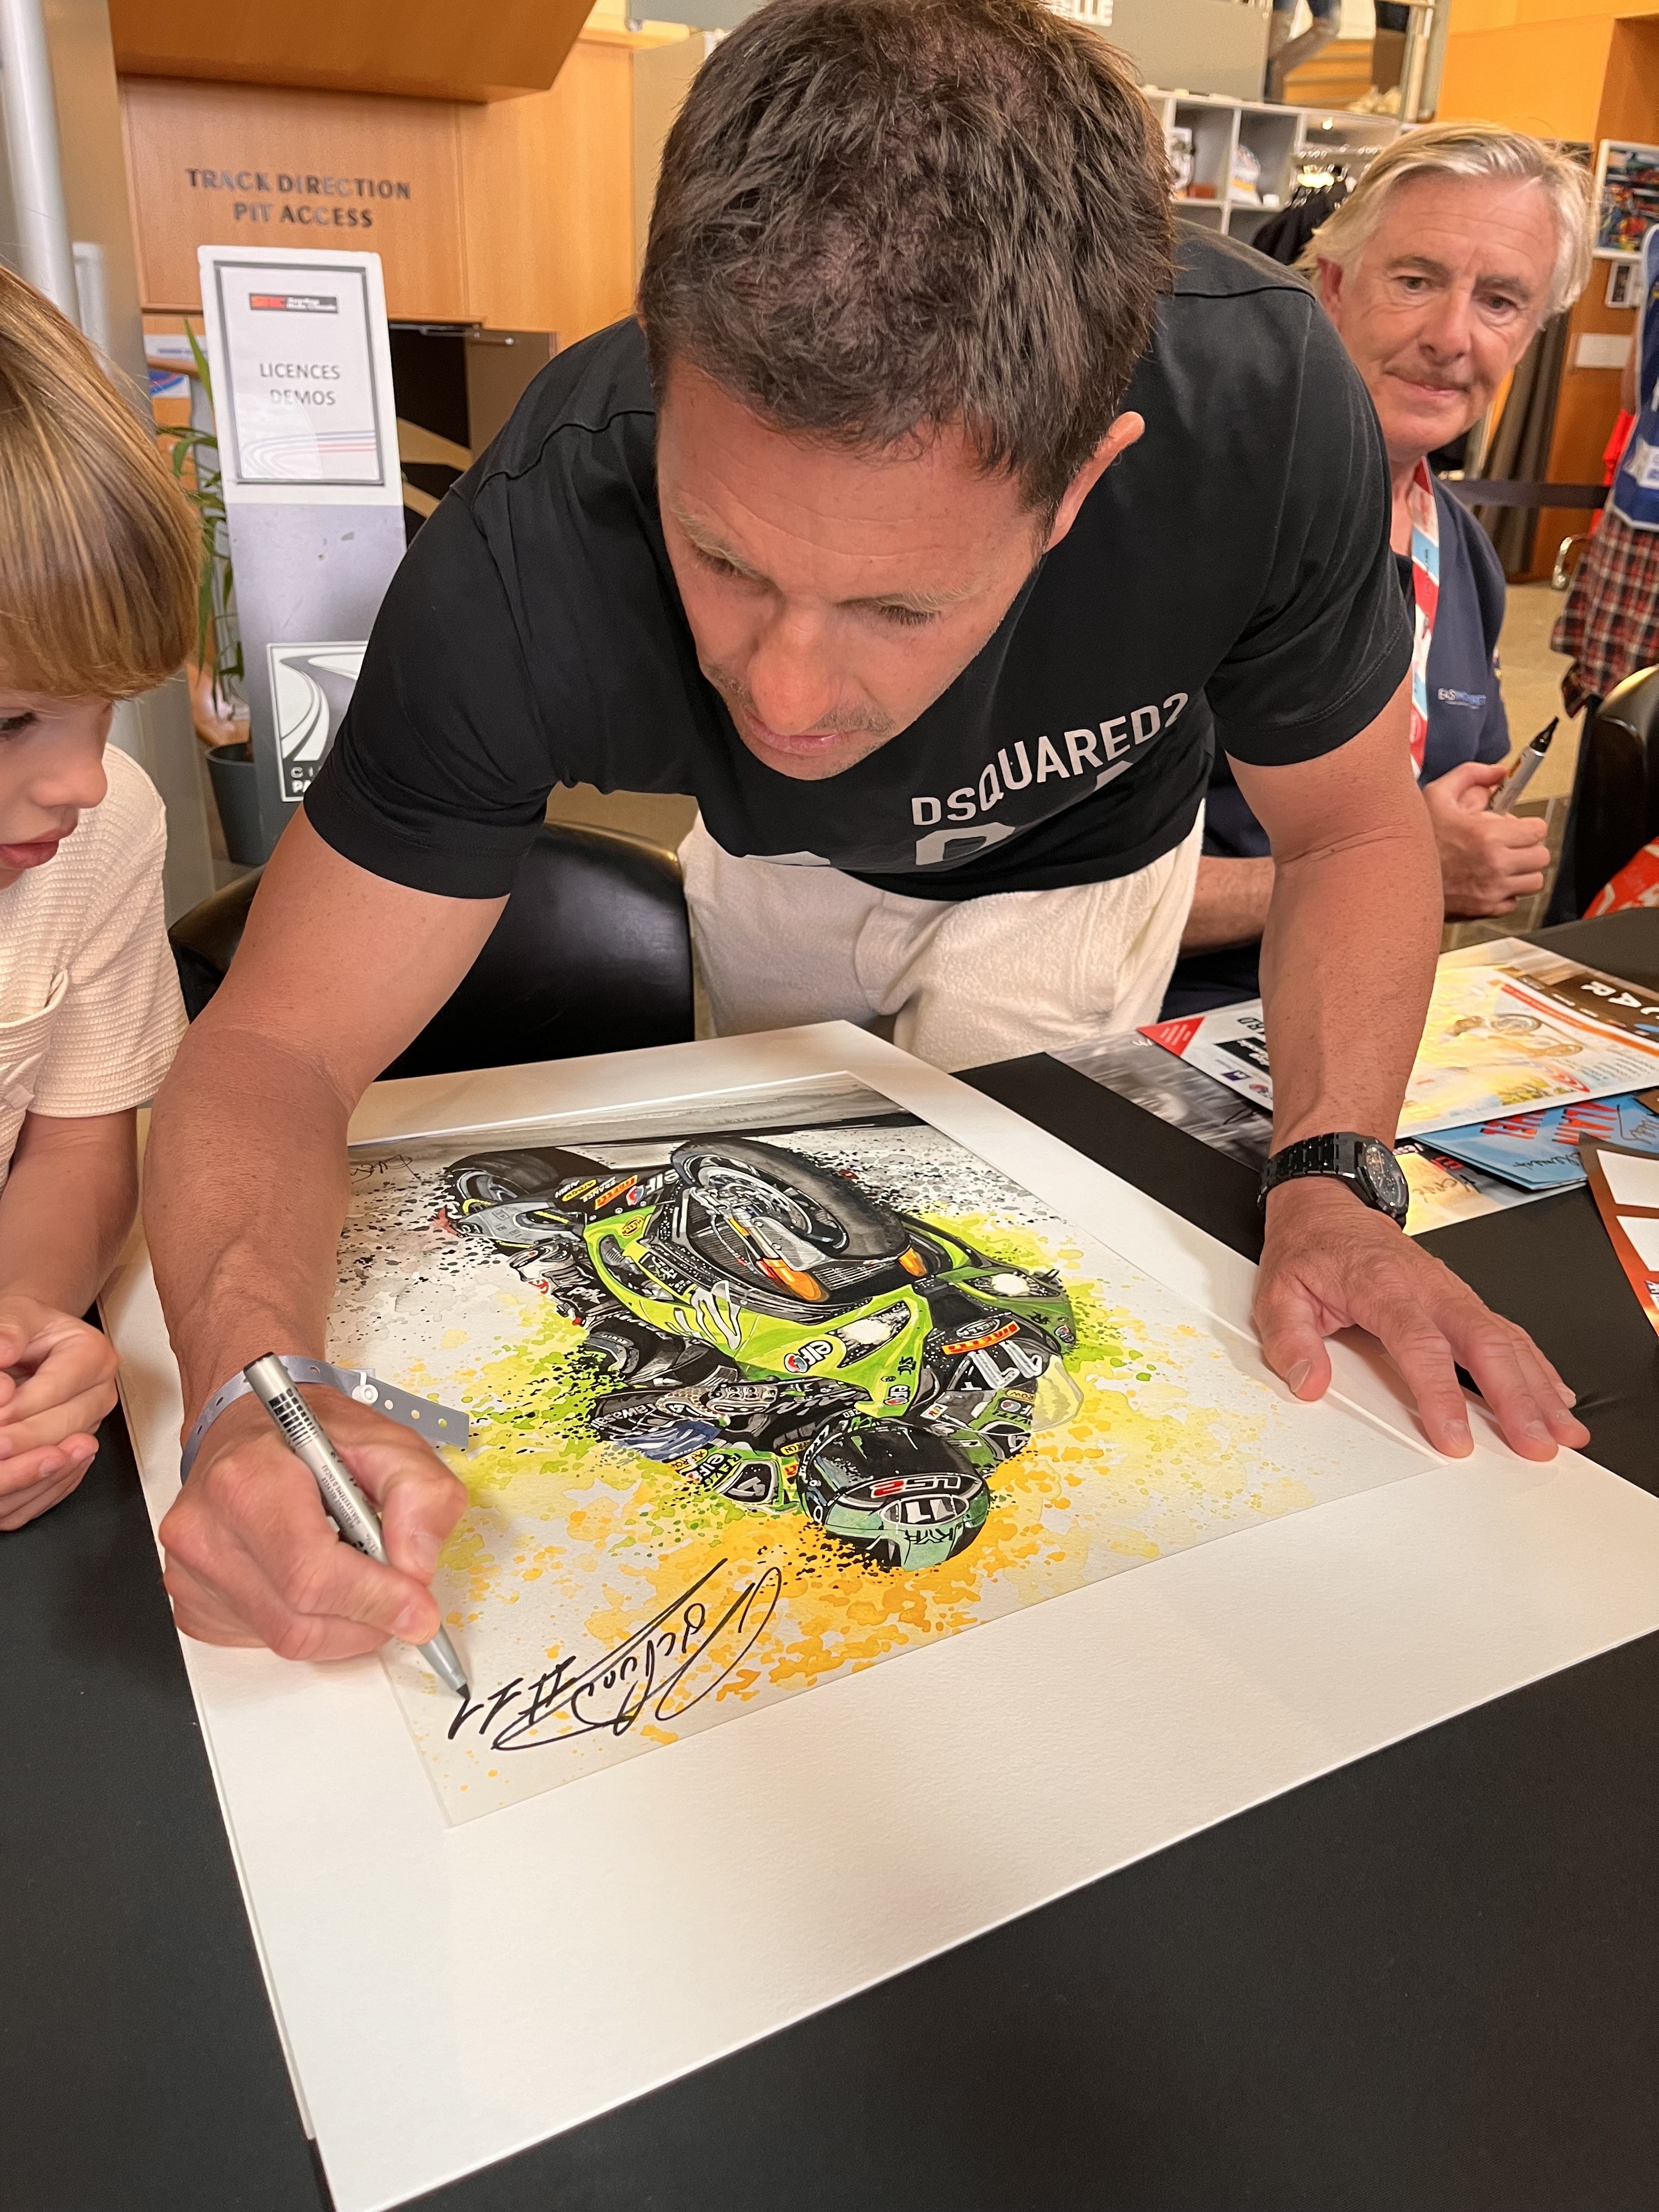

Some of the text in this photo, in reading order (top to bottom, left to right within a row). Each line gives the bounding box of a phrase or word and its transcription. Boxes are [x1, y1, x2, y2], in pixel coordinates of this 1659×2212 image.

[187, 168, 411, 200] TRACK DIRECTION
[234, 202, 374, 228] PIT ACCESS
[259, 362, 341, 381] LICENCES
[269, 388, 337, 406] DEMOS
[291, 765, 323, 778] CI
[911, 692, 1188, 825] DSQUARED2
[967, 1339, 1043, 1390] 11
